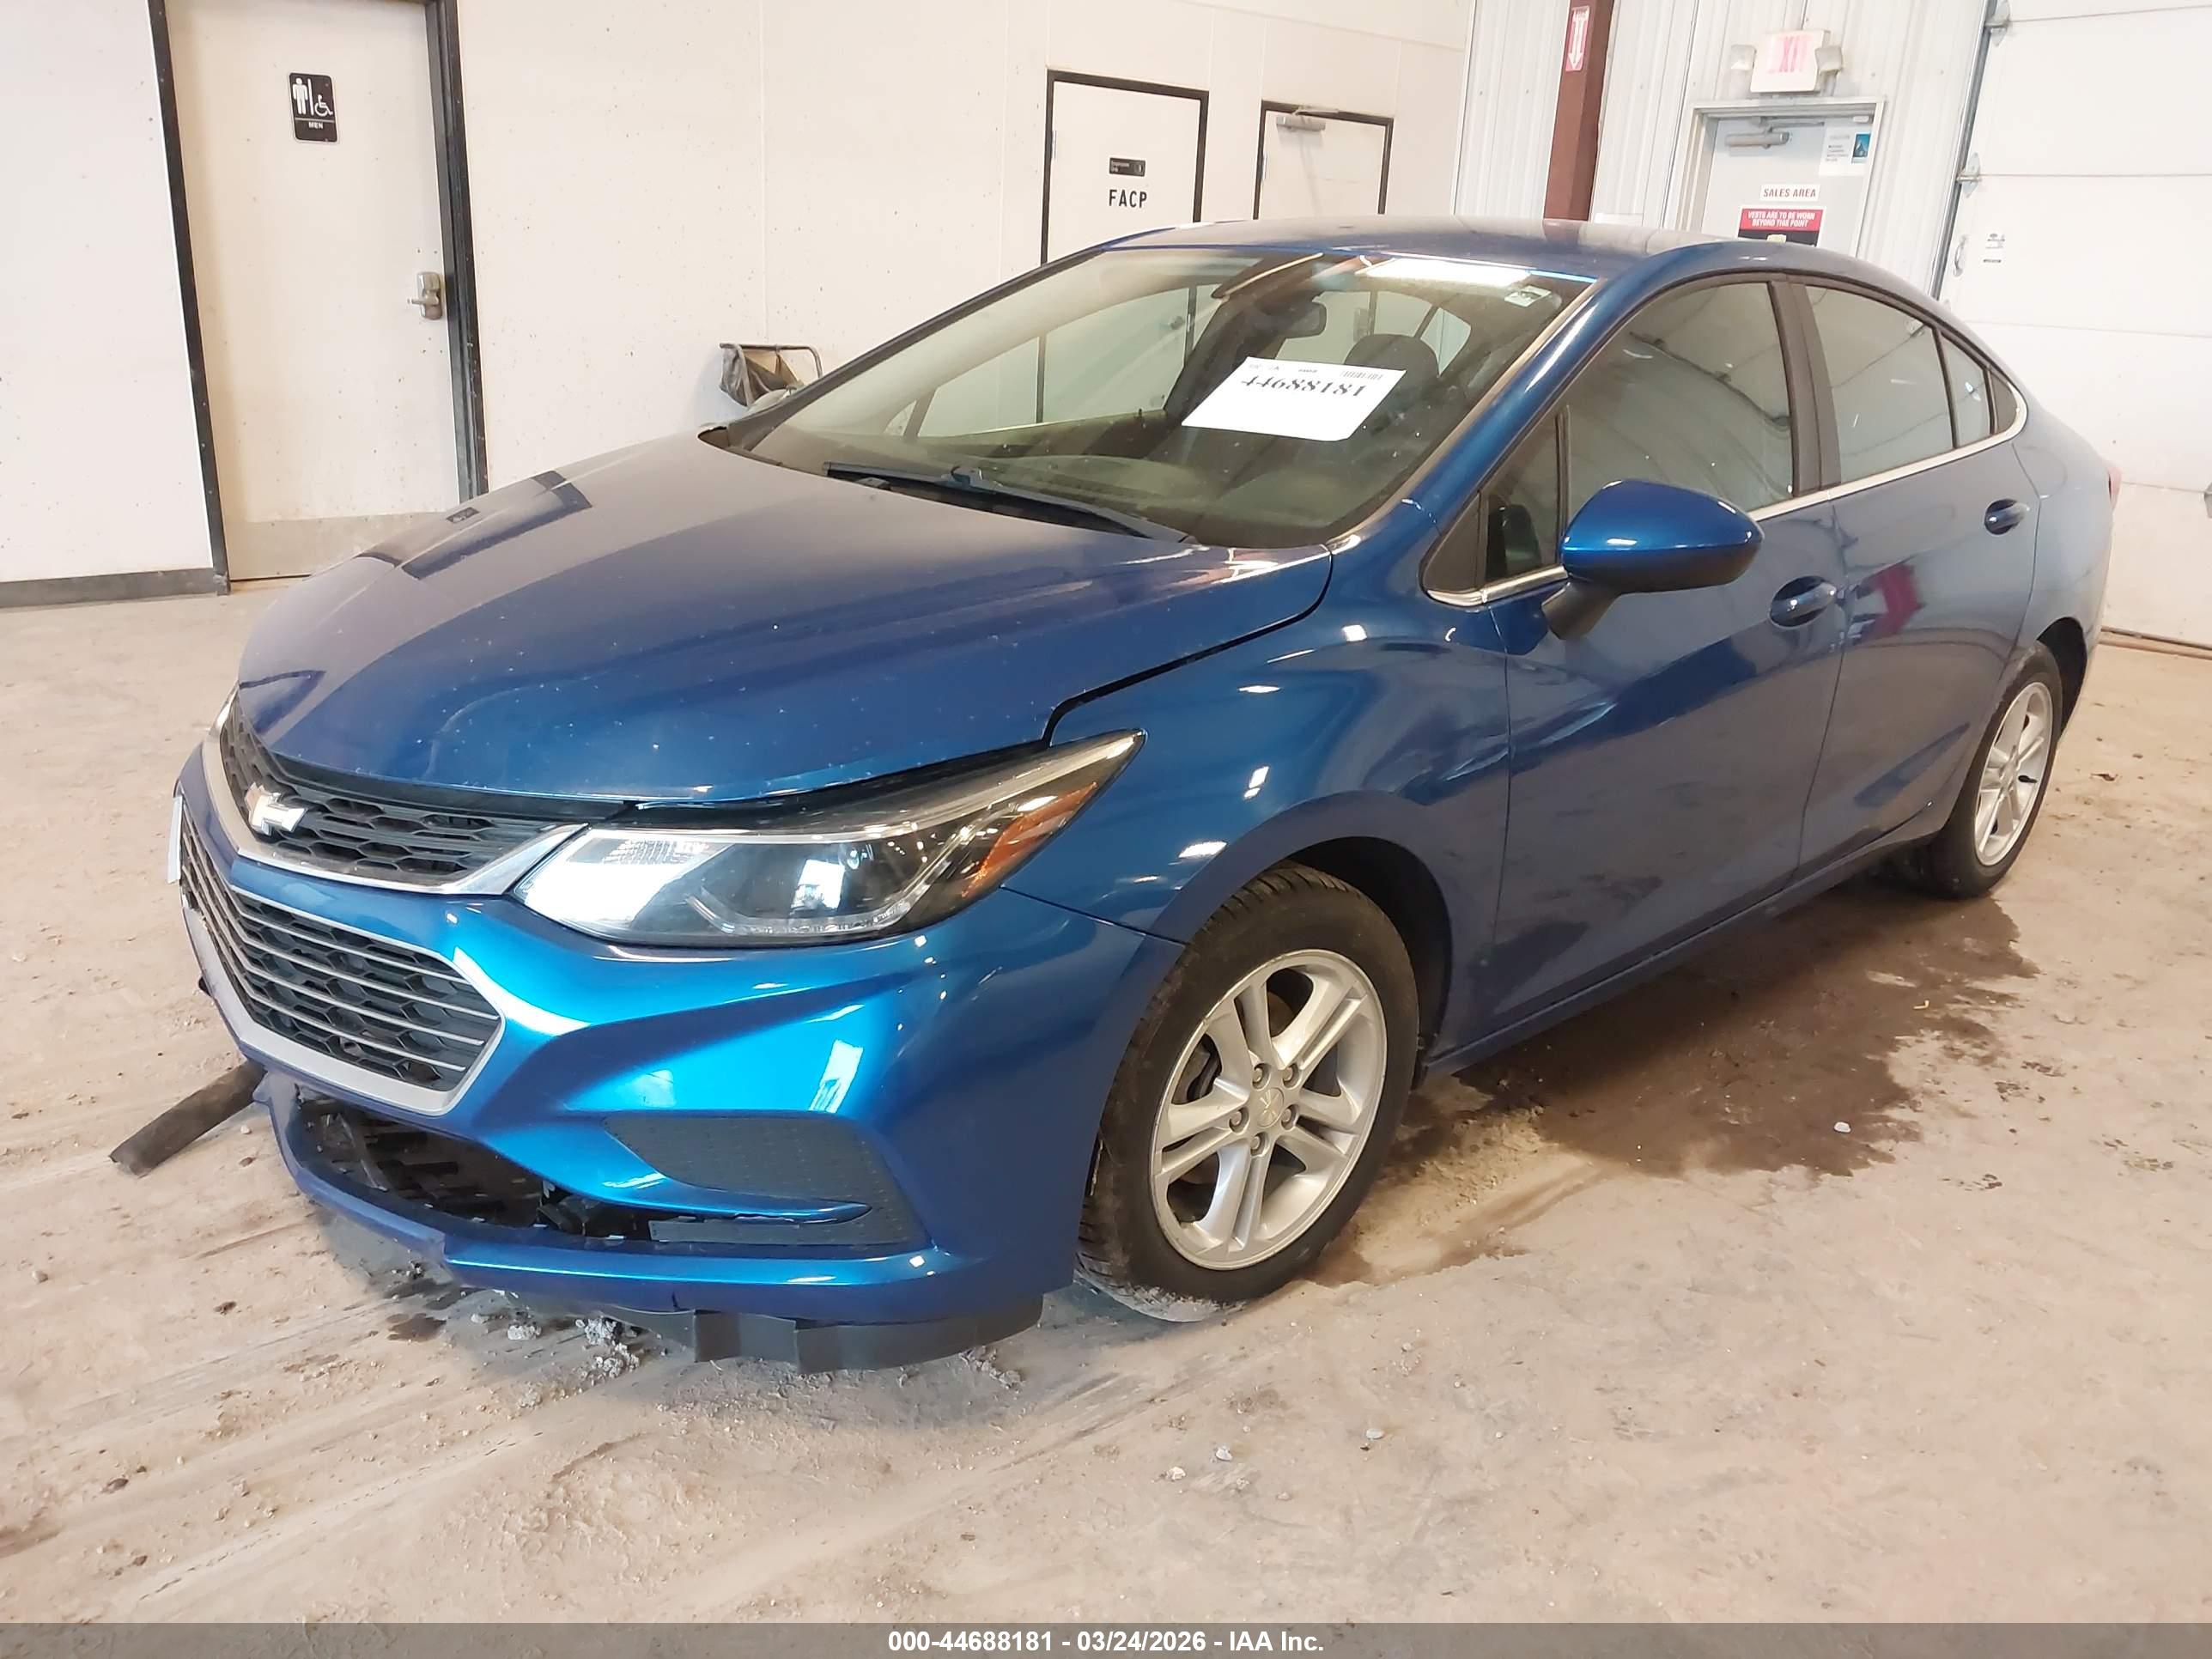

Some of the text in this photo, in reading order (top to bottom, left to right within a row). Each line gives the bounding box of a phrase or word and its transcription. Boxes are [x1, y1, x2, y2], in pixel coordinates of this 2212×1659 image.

[1763, 188, 1816, 198] SALES AREA
[1109, 189, 1147, 208] FACP
[1779, 211, 1787, 220] TO
[1790, 219, 1809, 228] POINT
[1241, 375, 1367, 397] 44688181
